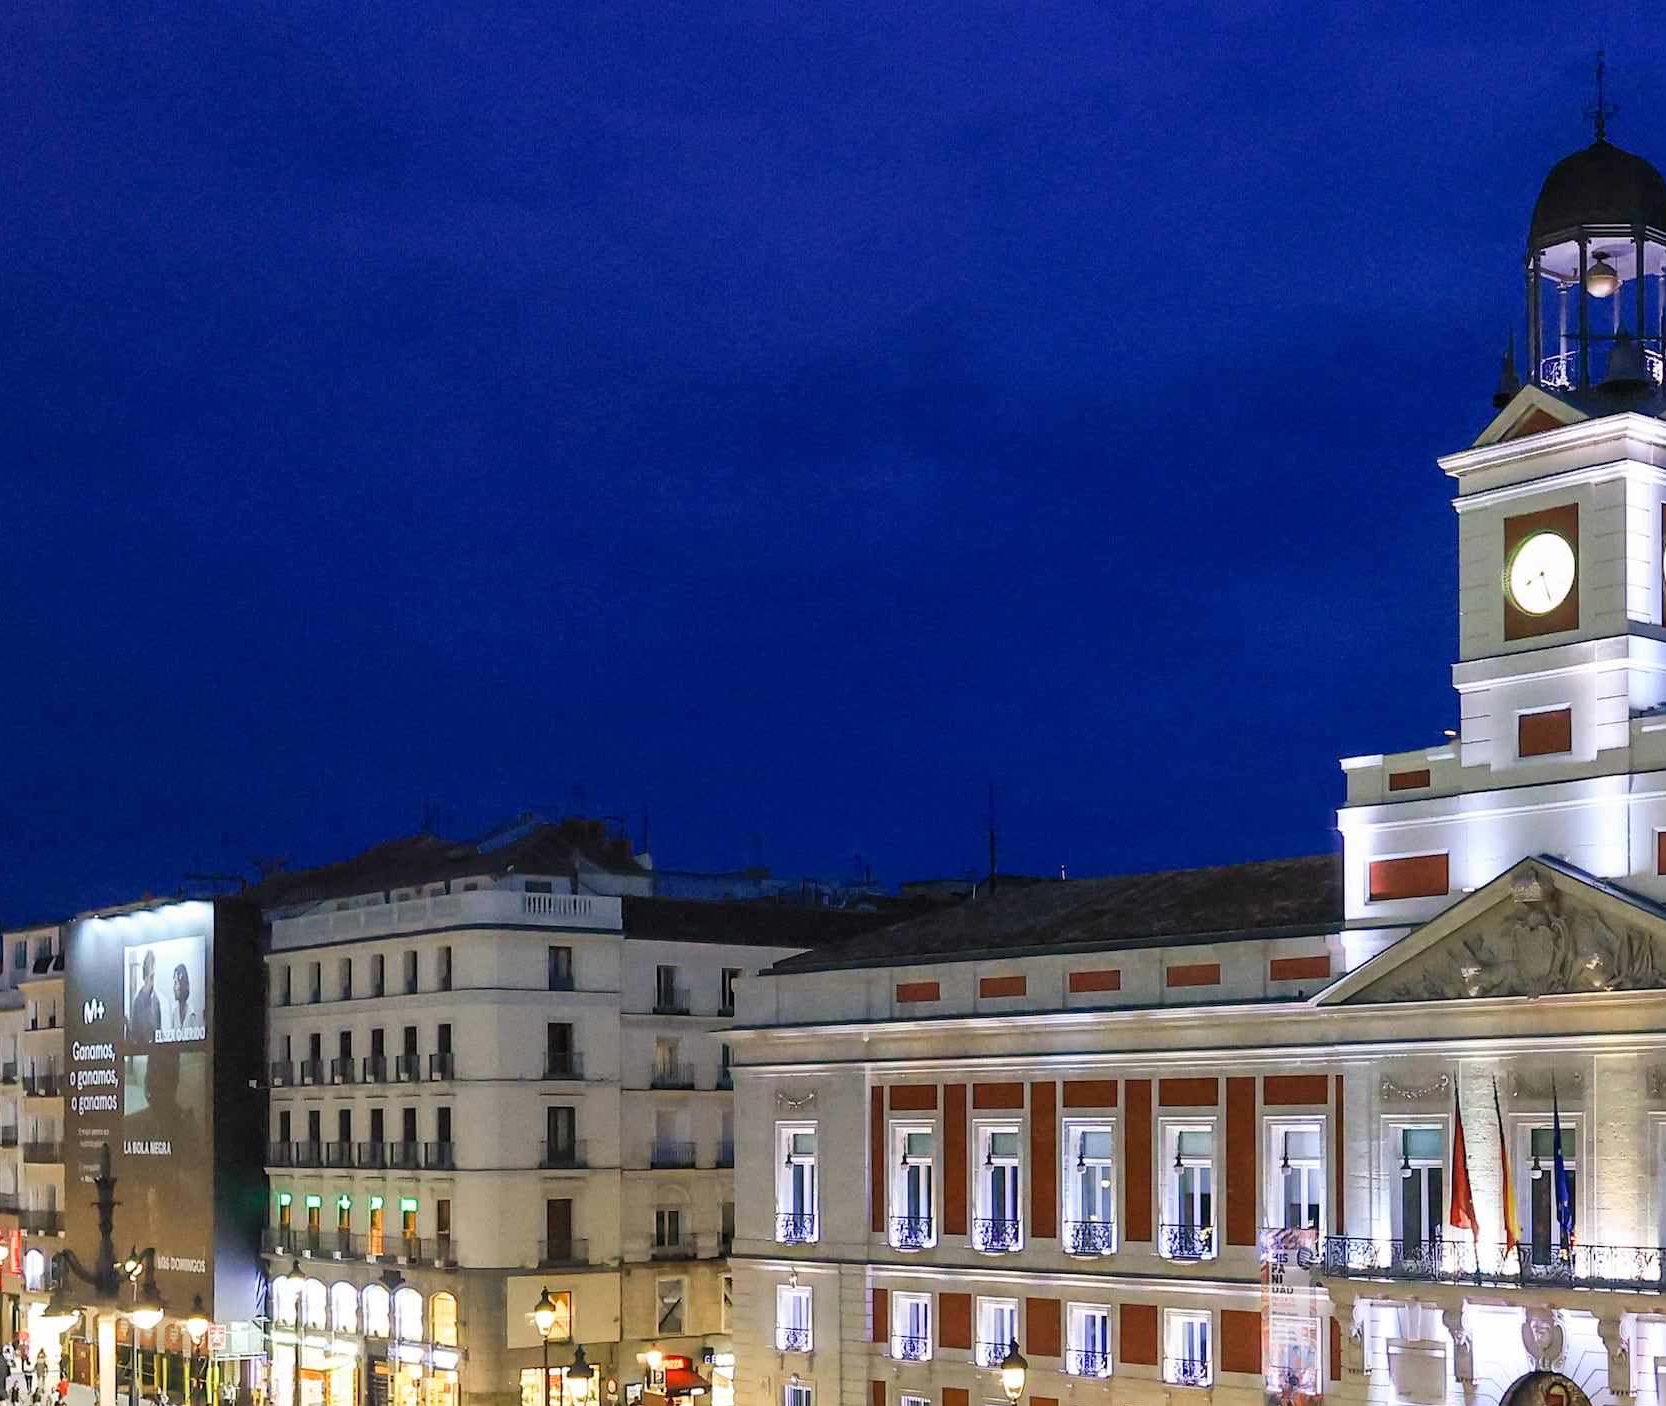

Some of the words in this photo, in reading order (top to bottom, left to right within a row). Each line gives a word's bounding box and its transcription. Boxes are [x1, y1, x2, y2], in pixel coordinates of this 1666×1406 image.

[154, 1029, 163, 1043] EL
[163, 1028, 176, 1042] SER
[176, 1026, 206, 1042] QUERIDO
[72, 1041, 116, 1063] Ganamos,
[69, 1073, 76, 1086] o
[77, 1069, 119, 1091] ganamos,
[71, 1098, 77, 1111] o
[78, 1094, 118, 1116] ganamos
[123, 1141, 133, 1155] LA
[133, 1141, 150, 1155] BOLA
[150, 1141, 172, 1155] NEGRA
[157, 1255, 170, 1270] LOS
[171, 1257, 206, 1273] DOMINGOS
[1272, 1274, 1283, 1284] NI
[662, 1359, 684, 1370] PIZZA
